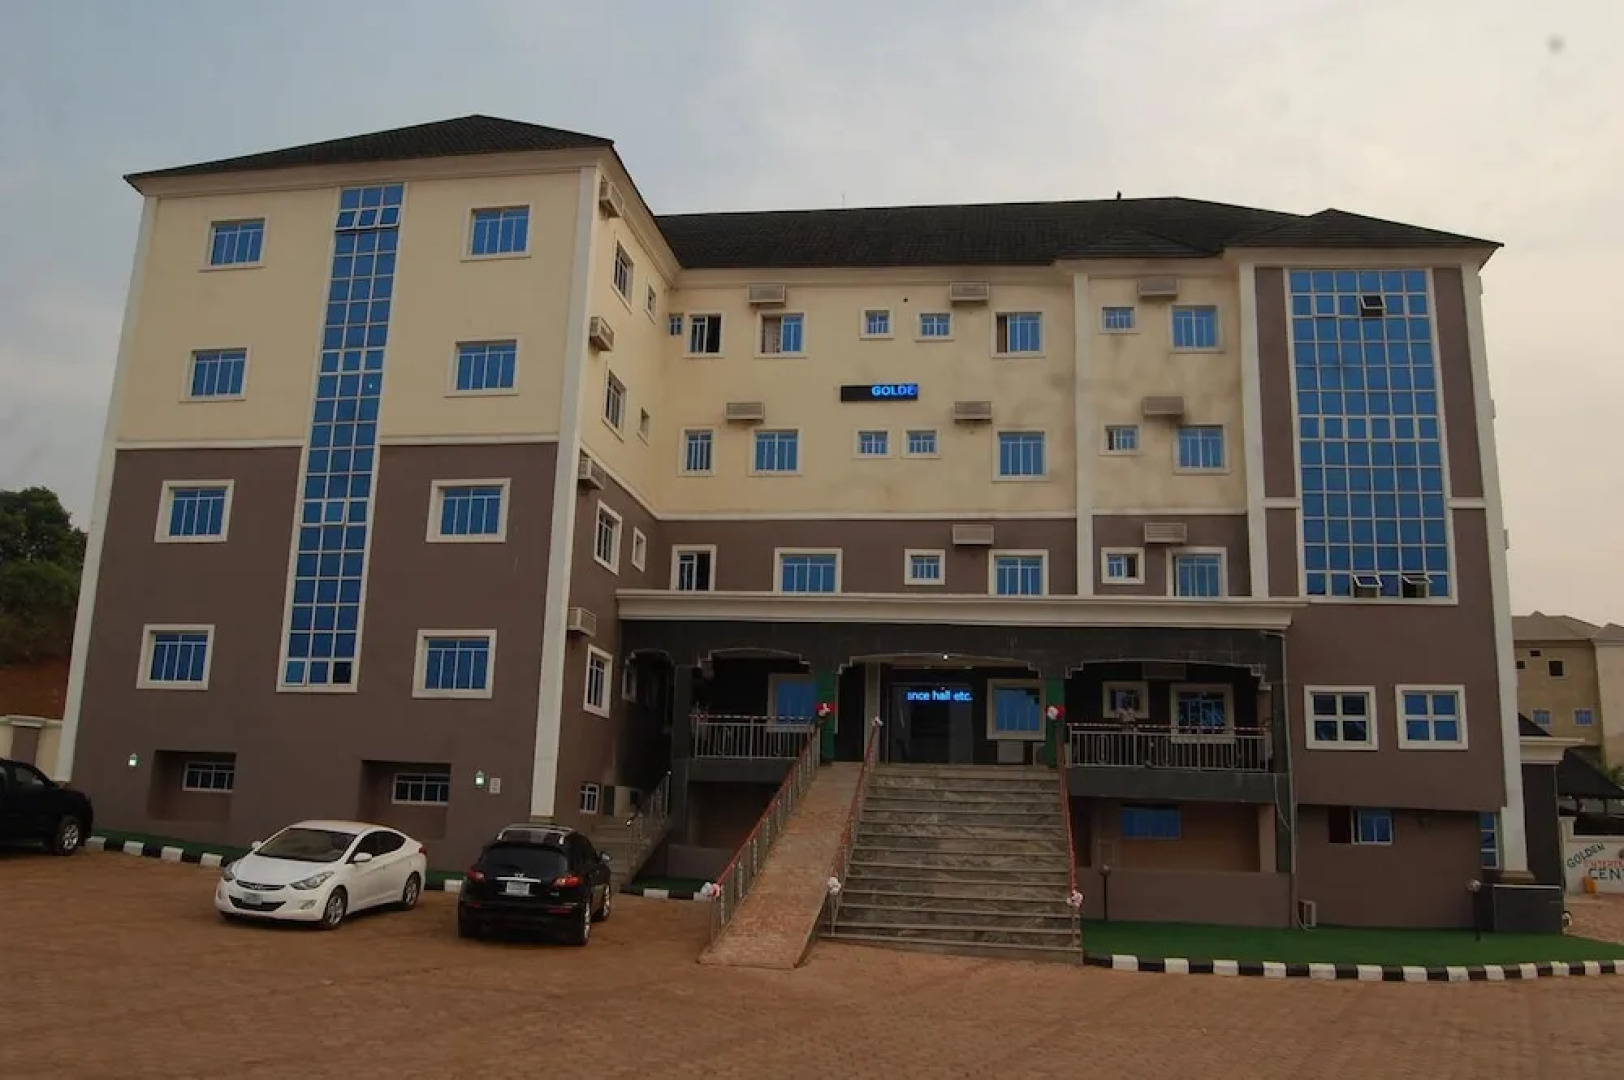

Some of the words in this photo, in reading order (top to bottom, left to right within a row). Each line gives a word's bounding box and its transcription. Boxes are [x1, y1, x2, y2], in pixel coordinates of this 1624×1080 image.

[931, 689, 951, 701] hall
[953, 691, 974, 702] etc.
[1566, 843, 1605, 868] GOLDEN
